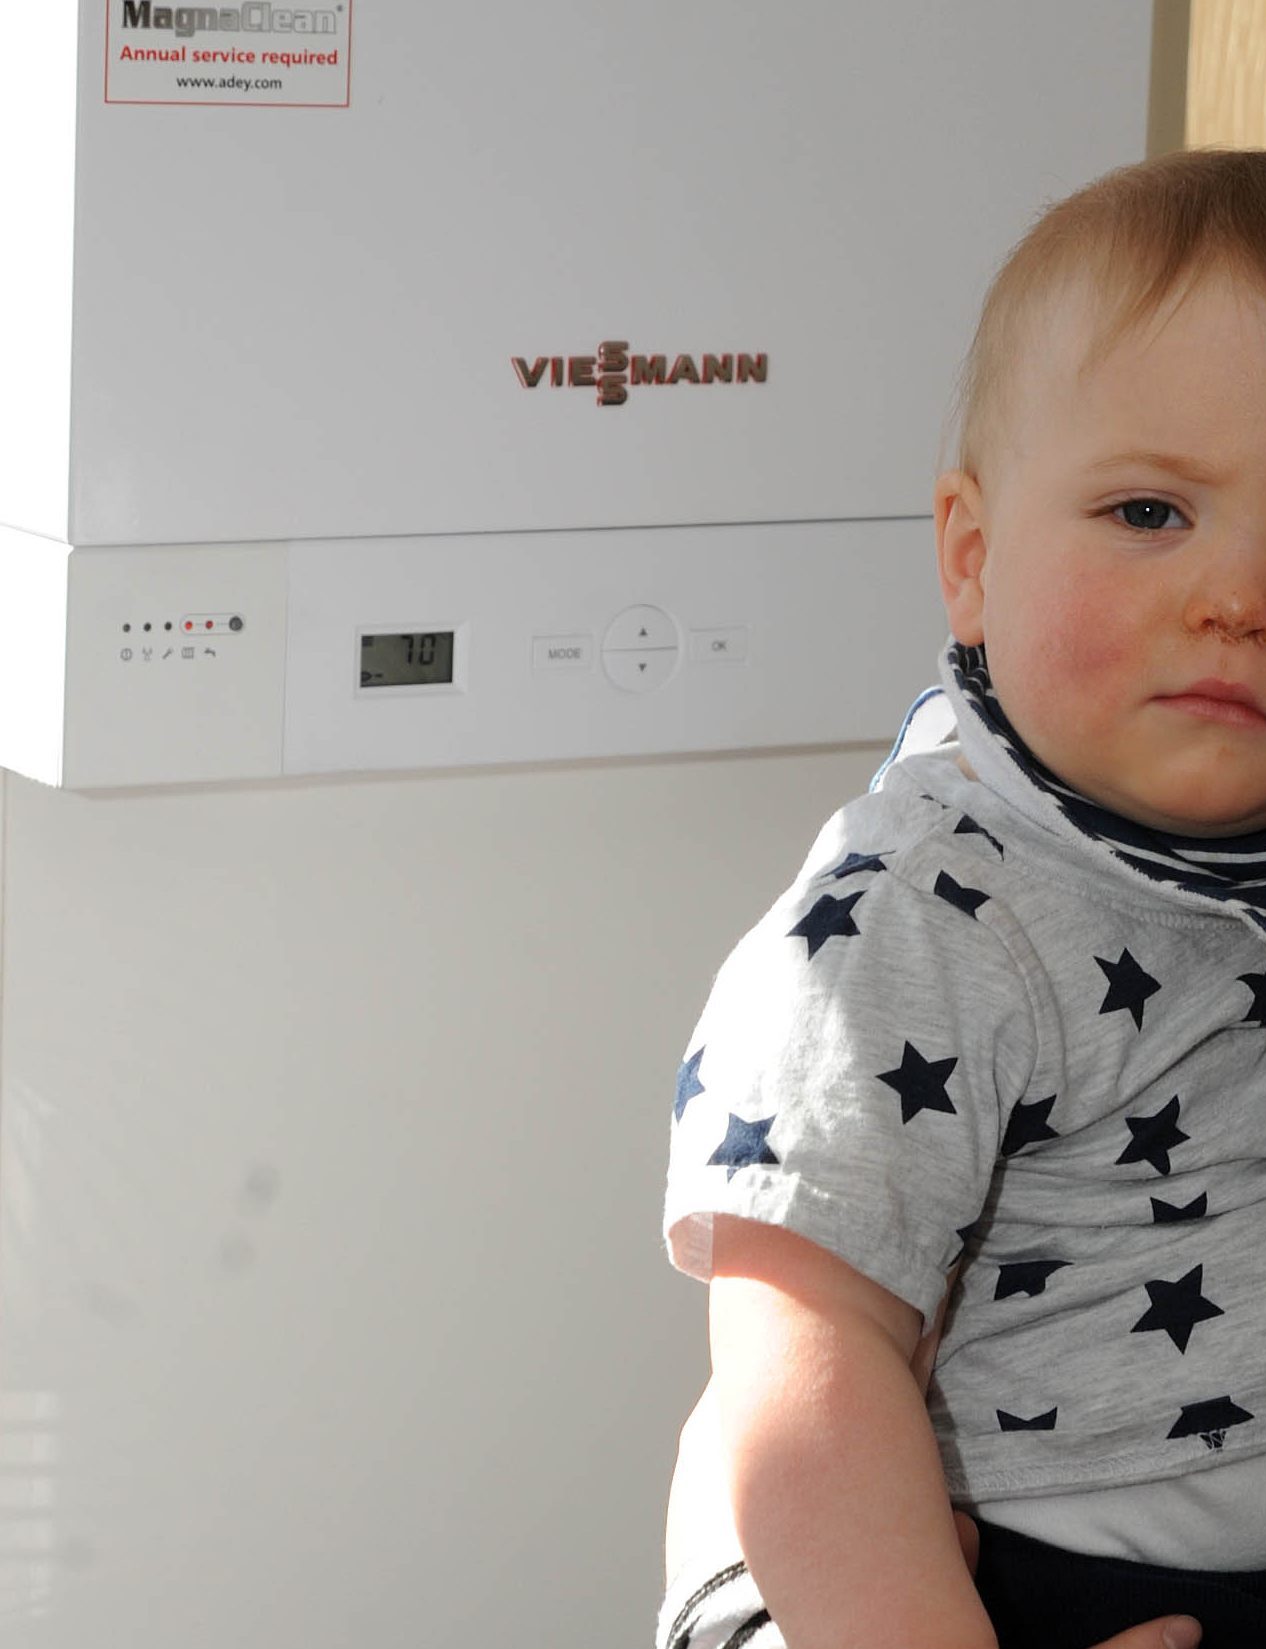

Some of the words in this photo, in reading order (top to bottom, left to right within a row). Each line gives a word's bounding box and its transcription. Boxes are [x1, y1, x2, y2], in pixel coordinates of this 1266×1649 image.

[122, 0, 337, 37] MagnaClean
[120, 46, 186, 62] Annual
[193, 47, 255, 63] service
[262, 50, 338, 68] required
[177, 75, 282, 91] www.adey.com
[511, 340, 768, 406] VIESSMANN
[401, 634, 436, 665] 70
[548, 648, 581, 660] MODE
[712, 640, 727, 652] OK
